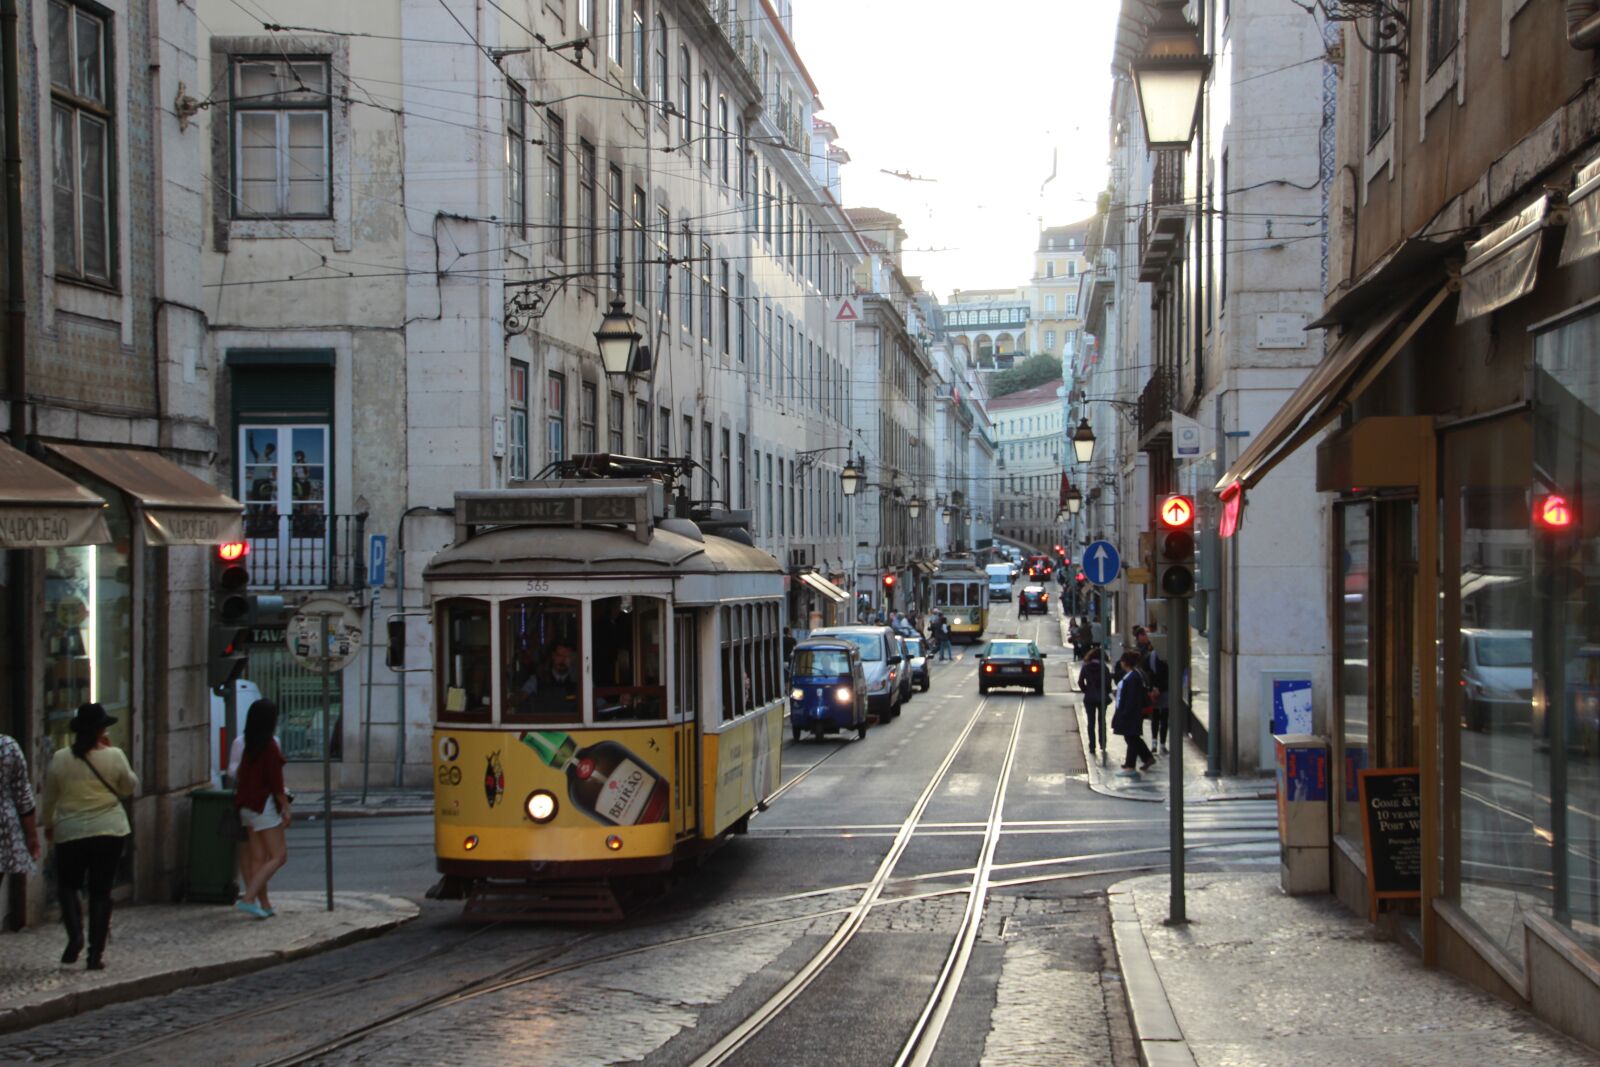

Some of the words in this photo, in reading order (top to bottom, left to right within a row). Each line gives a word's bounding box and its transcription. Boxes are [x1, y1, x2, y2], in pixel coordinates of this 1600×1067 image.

[594, 498, 627, 517] 28
[373, 540, 384, 580] P
[527, 580, 549, 592] 565
[608, 770, 642, 819] BEIRÃO
[1402, 797, 1411, 807] &
[1377, 810, 1389, 820] 10
[1379, 820, 1405, 831] PORT
